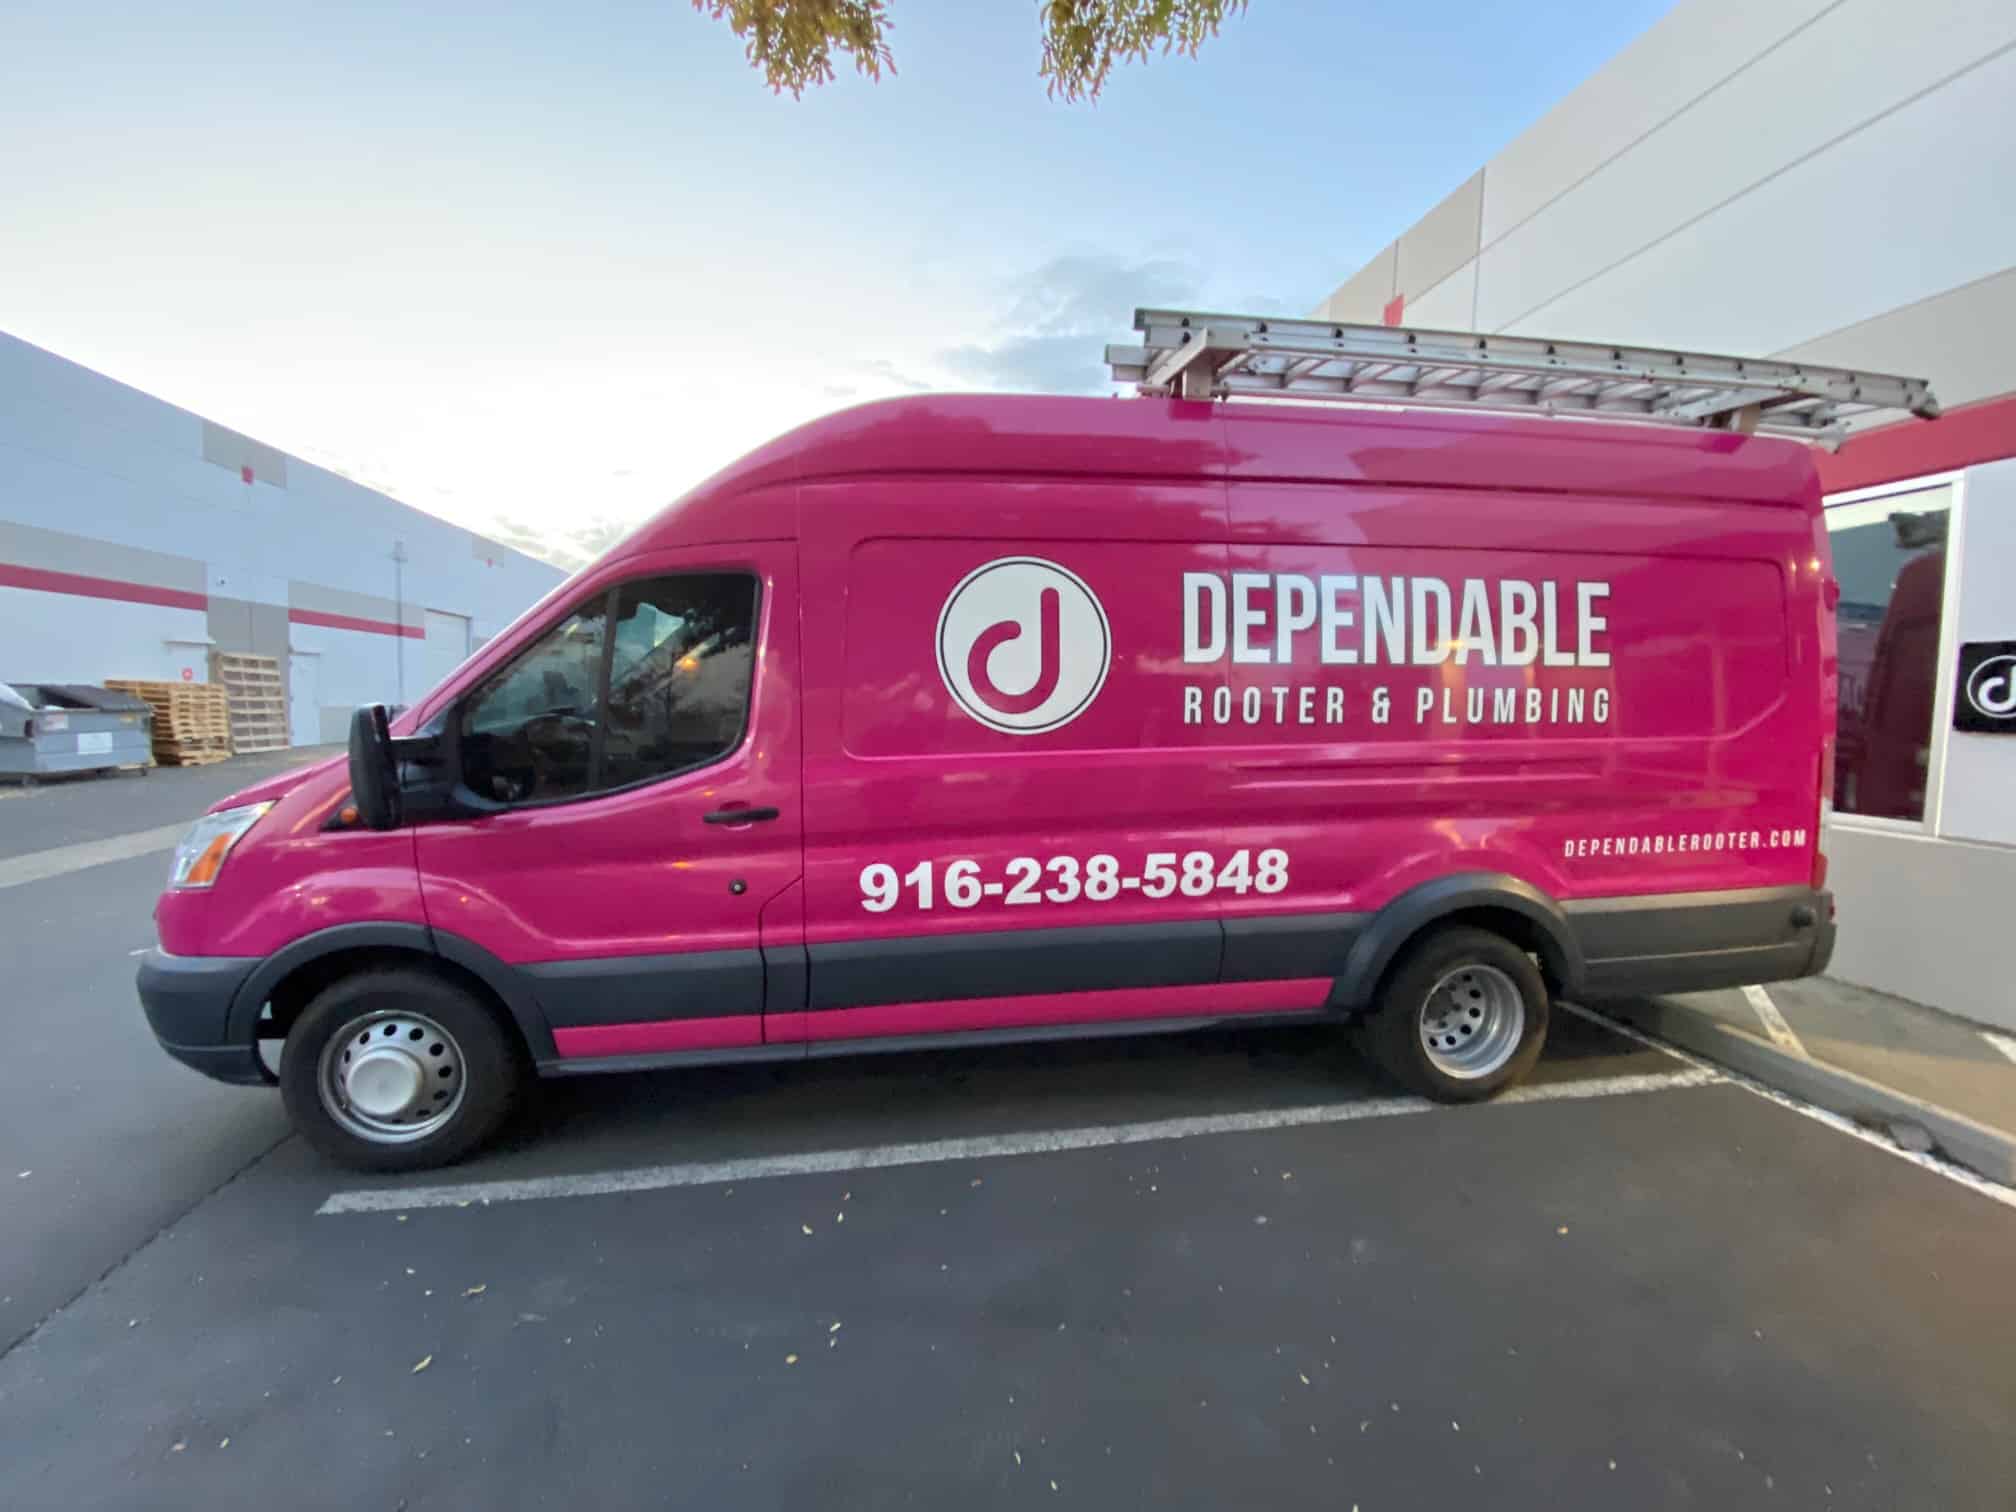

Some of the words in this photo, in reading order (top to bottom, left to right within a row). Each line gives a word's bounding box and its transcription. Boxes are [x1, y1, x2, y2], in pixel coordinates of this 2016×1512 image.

[1183, 572, 1611, 667] DEPENDABLE
[1184, 686, 1345, 724] ROOTER
[1372, 687, 1391, 723] &
[1416, 687, 1610, 724] PLUMBING
[1564, 829, 1806, 857] DEPENDABLEROOTER.COM
[859, 848, 1289, 912] 916-238-5848
